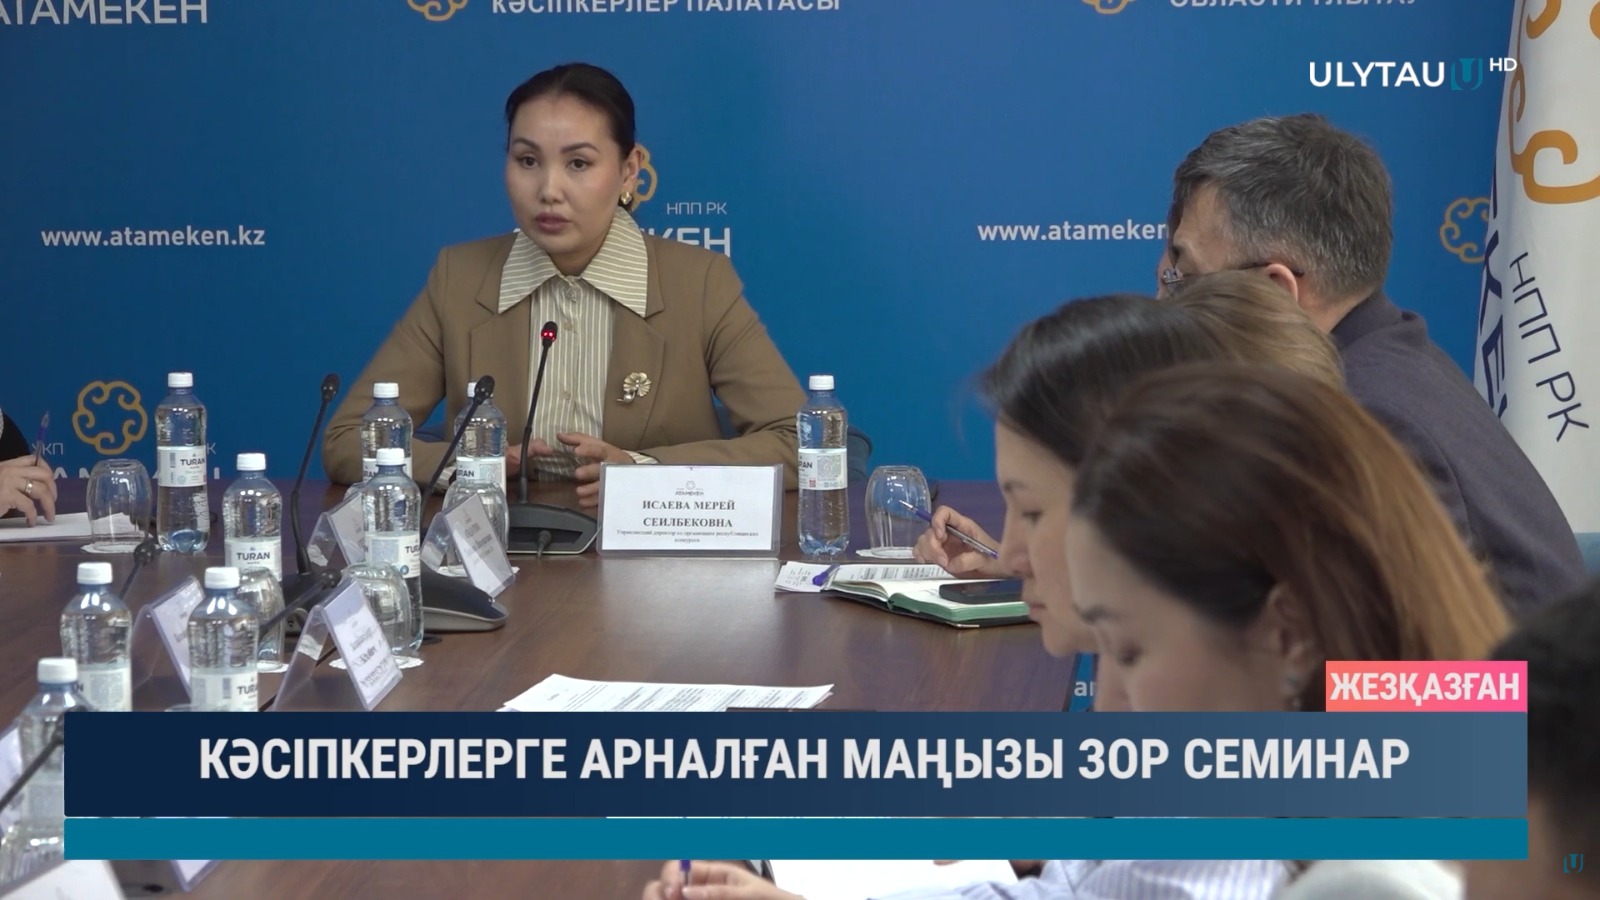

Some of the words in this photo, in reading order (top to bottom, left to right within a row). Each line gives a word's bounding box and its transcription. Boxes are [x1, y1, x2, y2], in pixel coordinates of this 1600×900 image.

[666, 202, 702, 215] НПП
[706, 202, 728, 215] РК
[41, 225, 266, 247] www.atameken.kz
[977, 219, 1168, 241] www.atameken
[1509, 252, 1562, 365] НПП
[1535, 371, 1590, 443] РК
[642, 500, 691, 510] ИСАЕВА
[694, 499, 736, 511] МЕРЕЙ
[642, 517, 734, 528] СЕИЛБЕКОВНА
[236, 552, 271, 561] TURAN
